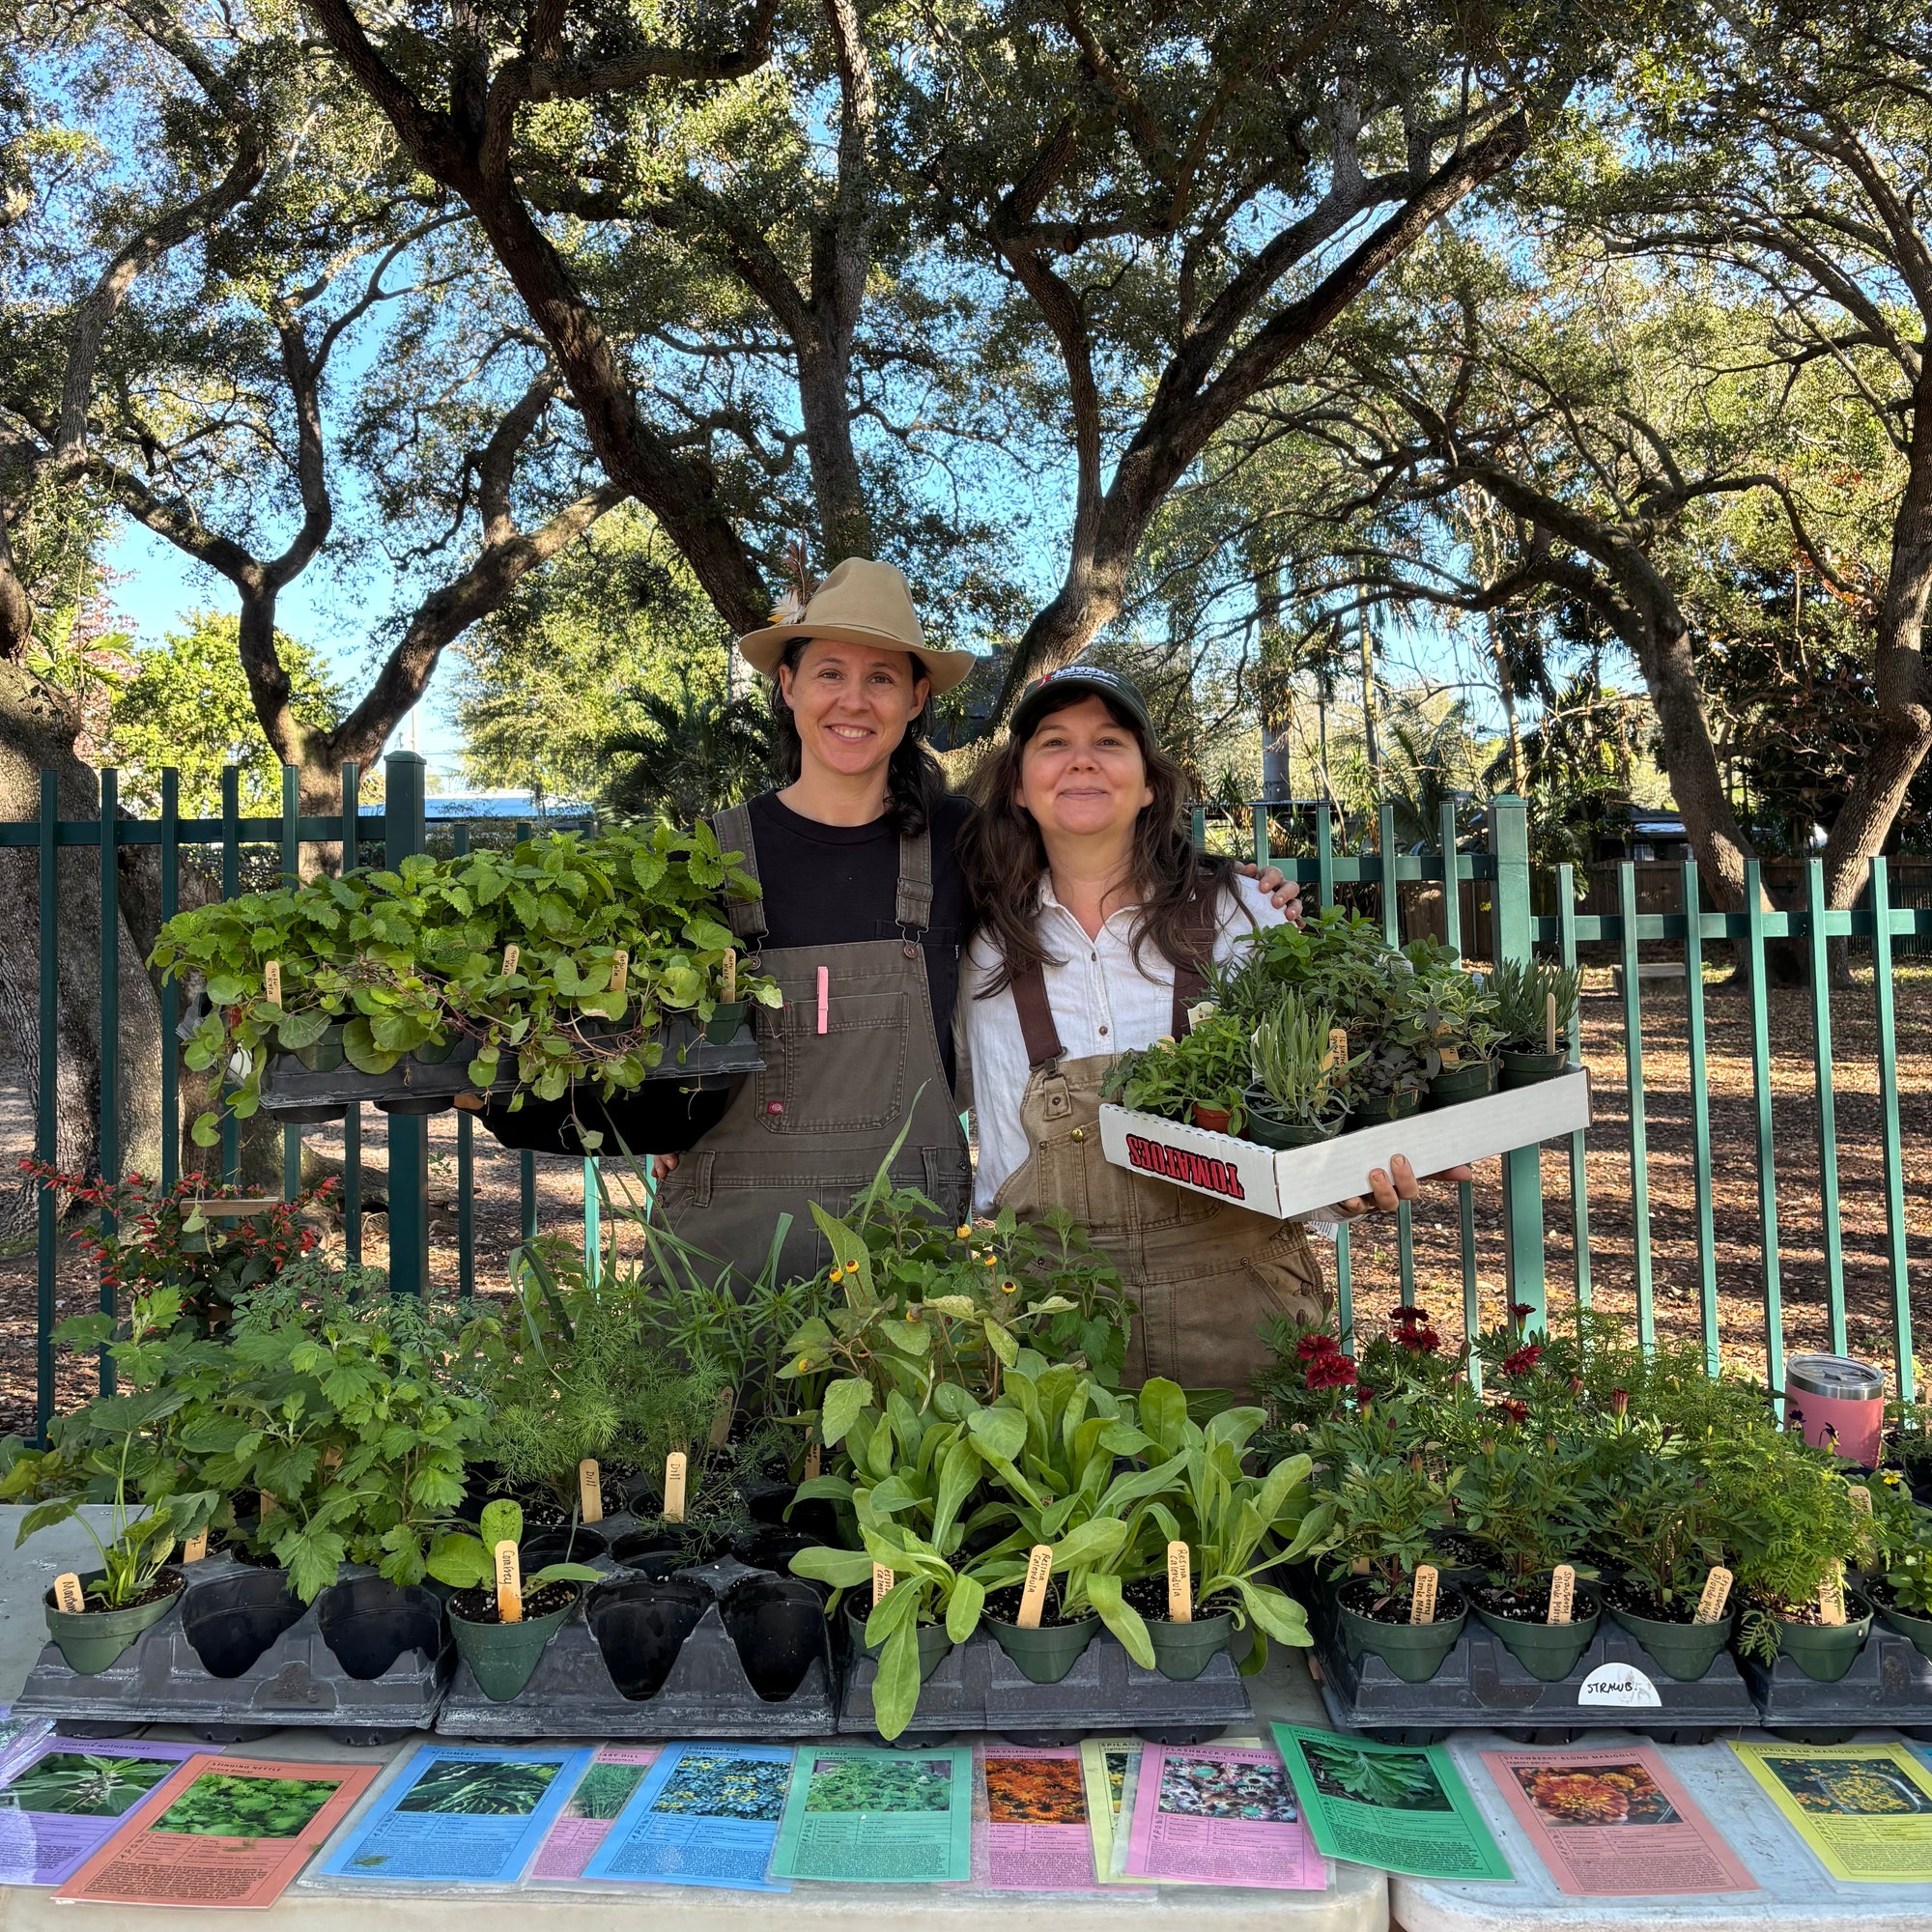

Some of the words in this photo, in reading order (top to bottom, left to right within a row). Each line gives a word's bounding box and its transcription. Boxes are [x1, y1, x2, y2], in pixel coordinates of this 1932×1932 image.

[1126, 1133, 1245, 1200] TOMATOES
[585, 1471, 597, 1488] Dill
[669, 1463, 681, 1480] Dill
[498, 1549, 515, 1585] Comfrey
[1178, 1548, 1188, 1579] Resina
[1586, 1682, 1638, 1694] STRAWB.
